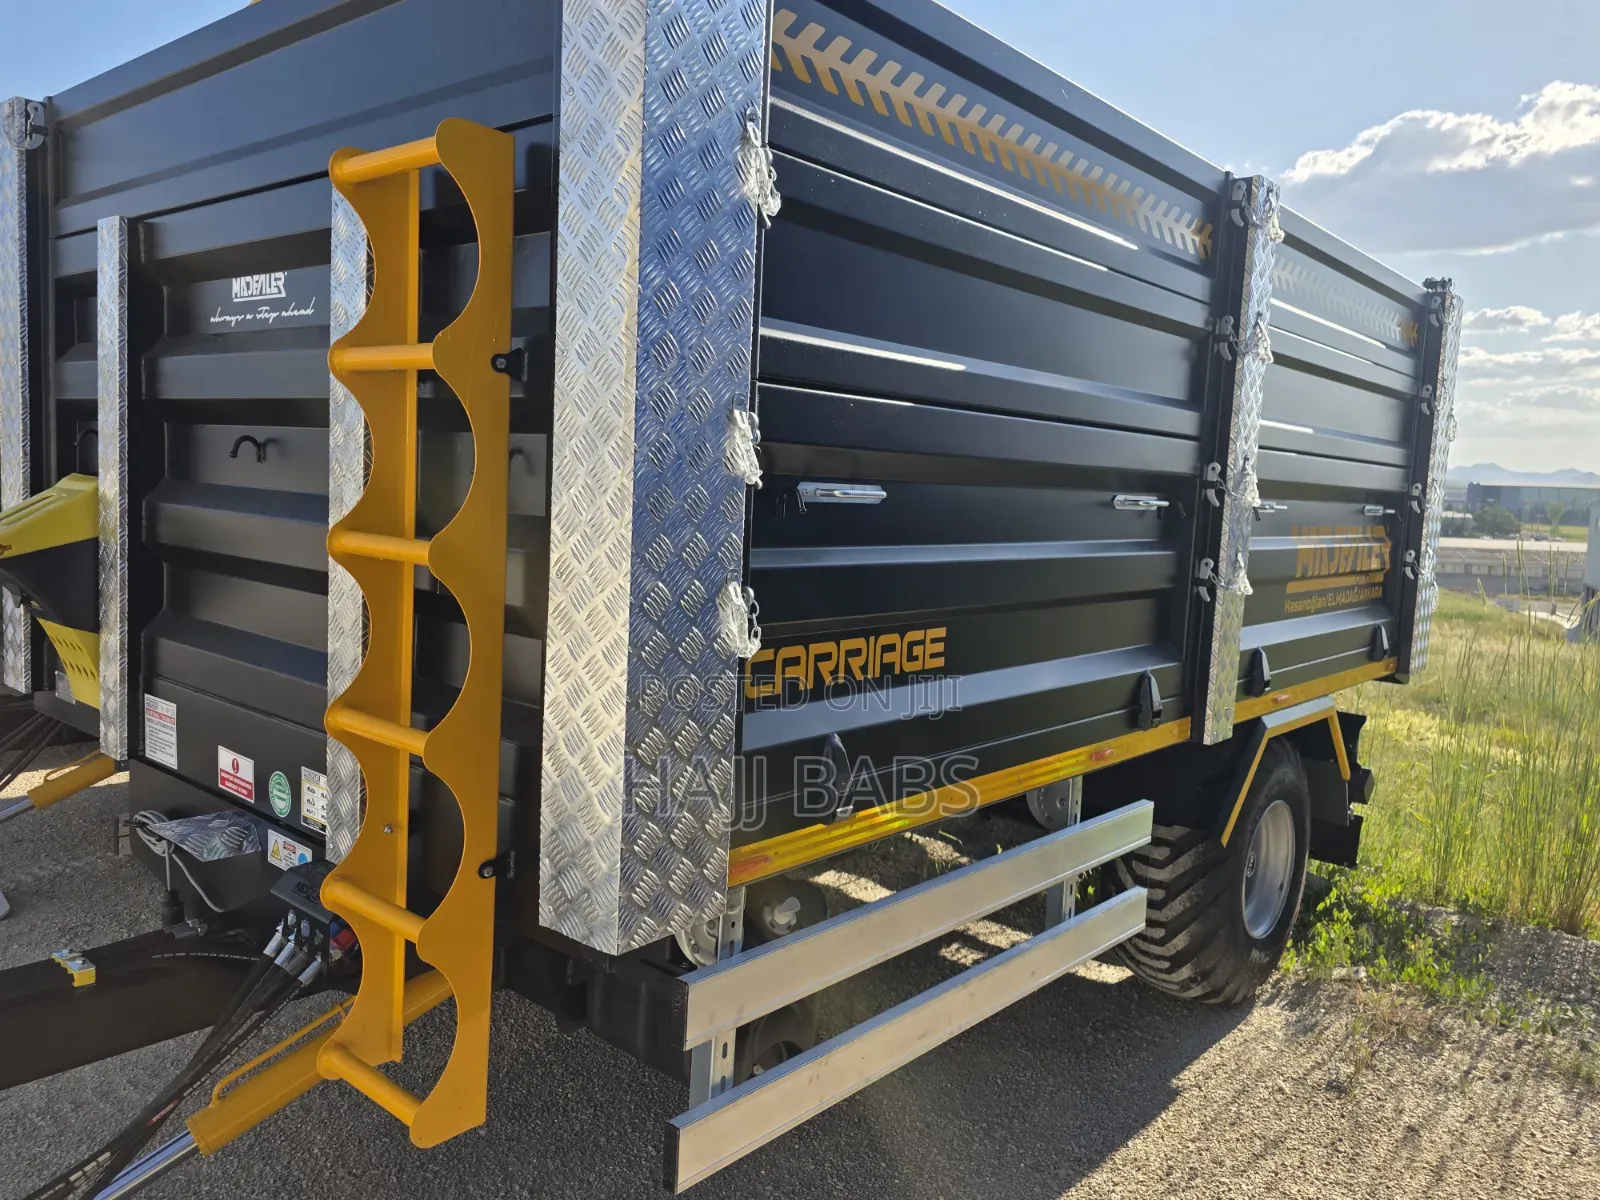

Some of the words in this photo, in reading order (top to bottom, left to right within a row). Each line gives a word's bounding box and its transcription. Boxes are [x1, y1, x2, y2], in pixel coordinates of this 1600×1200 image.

[210, 306, 244, 327] always
[245, 312, 254, 320] a
[281, 296, 316, 316] ahead
[745, 626, 947, 699] CARRIAGE
